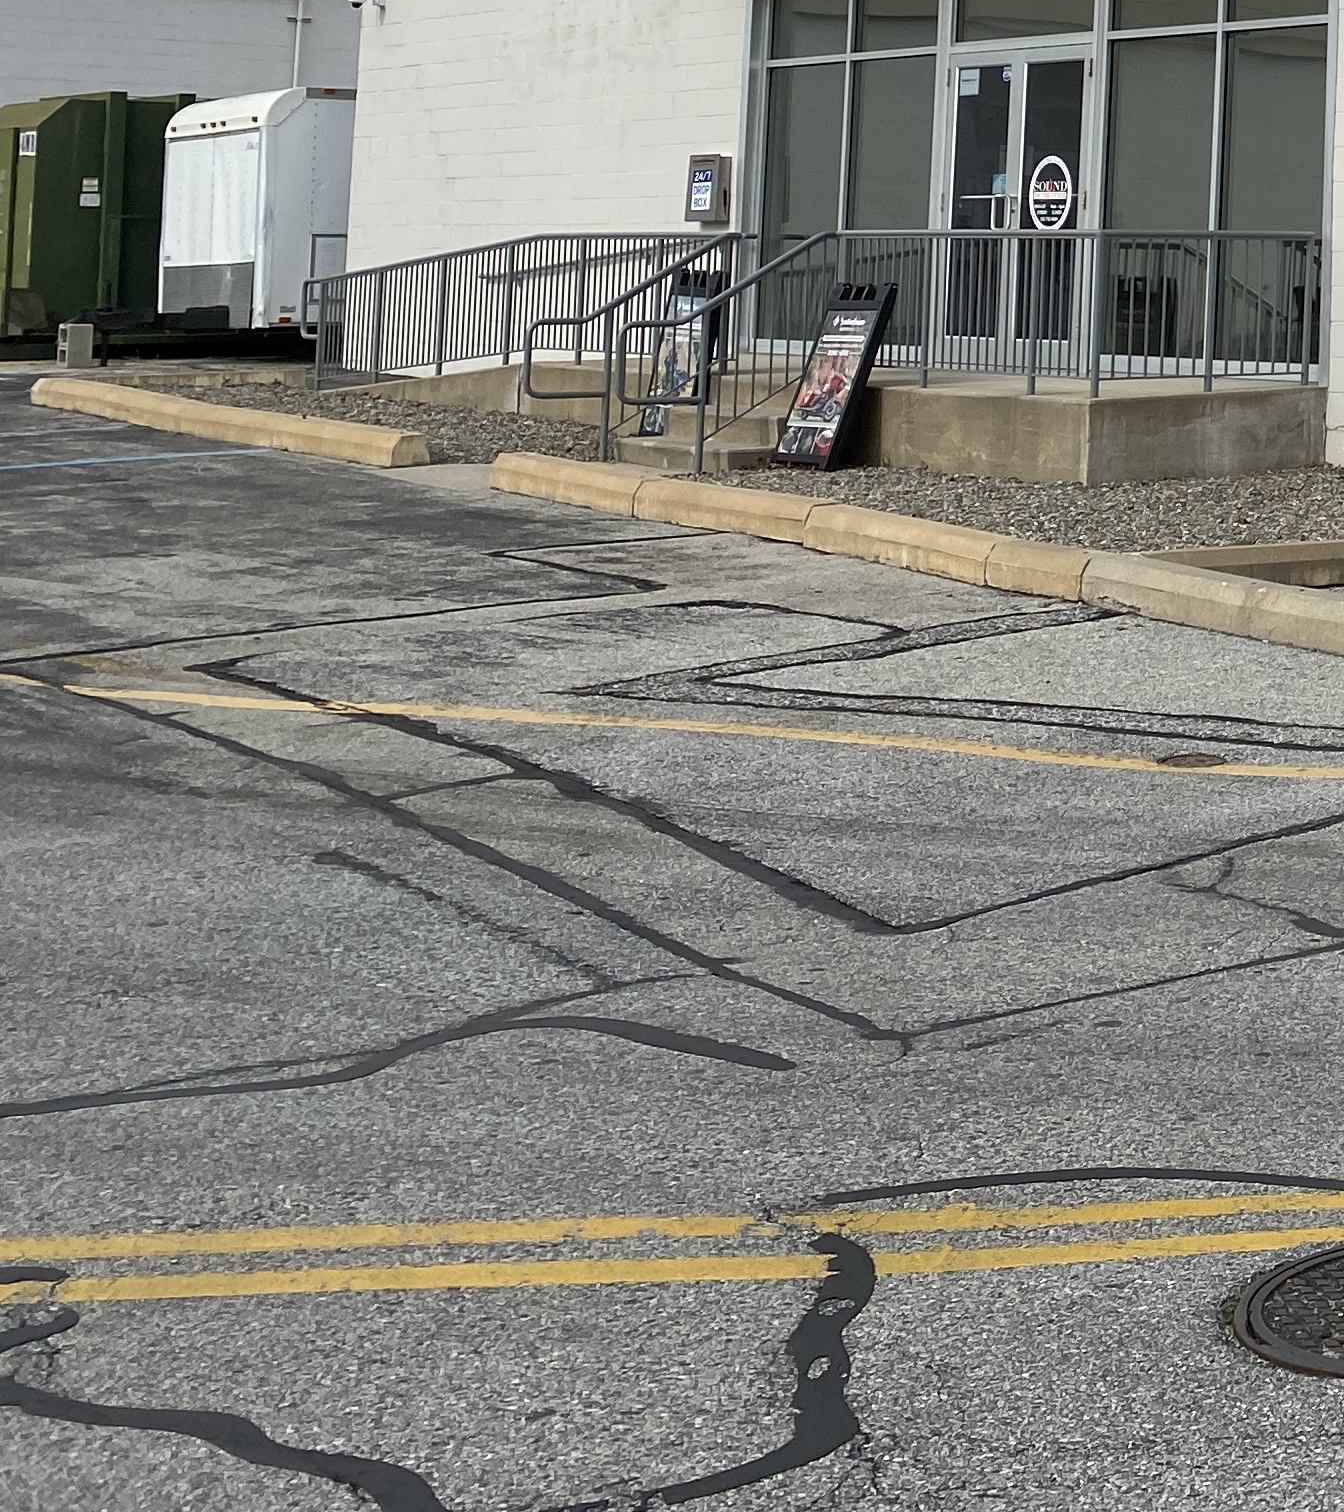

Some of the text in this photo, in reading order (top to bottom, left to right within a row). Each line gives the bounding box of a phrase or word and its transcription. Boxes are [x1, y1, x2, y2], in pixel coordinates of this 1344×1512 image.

[693, 170, 712, 182] 24/7
[1033, 180, 1067, 192] SOUND
[693, 197, 707, 208] BOX
